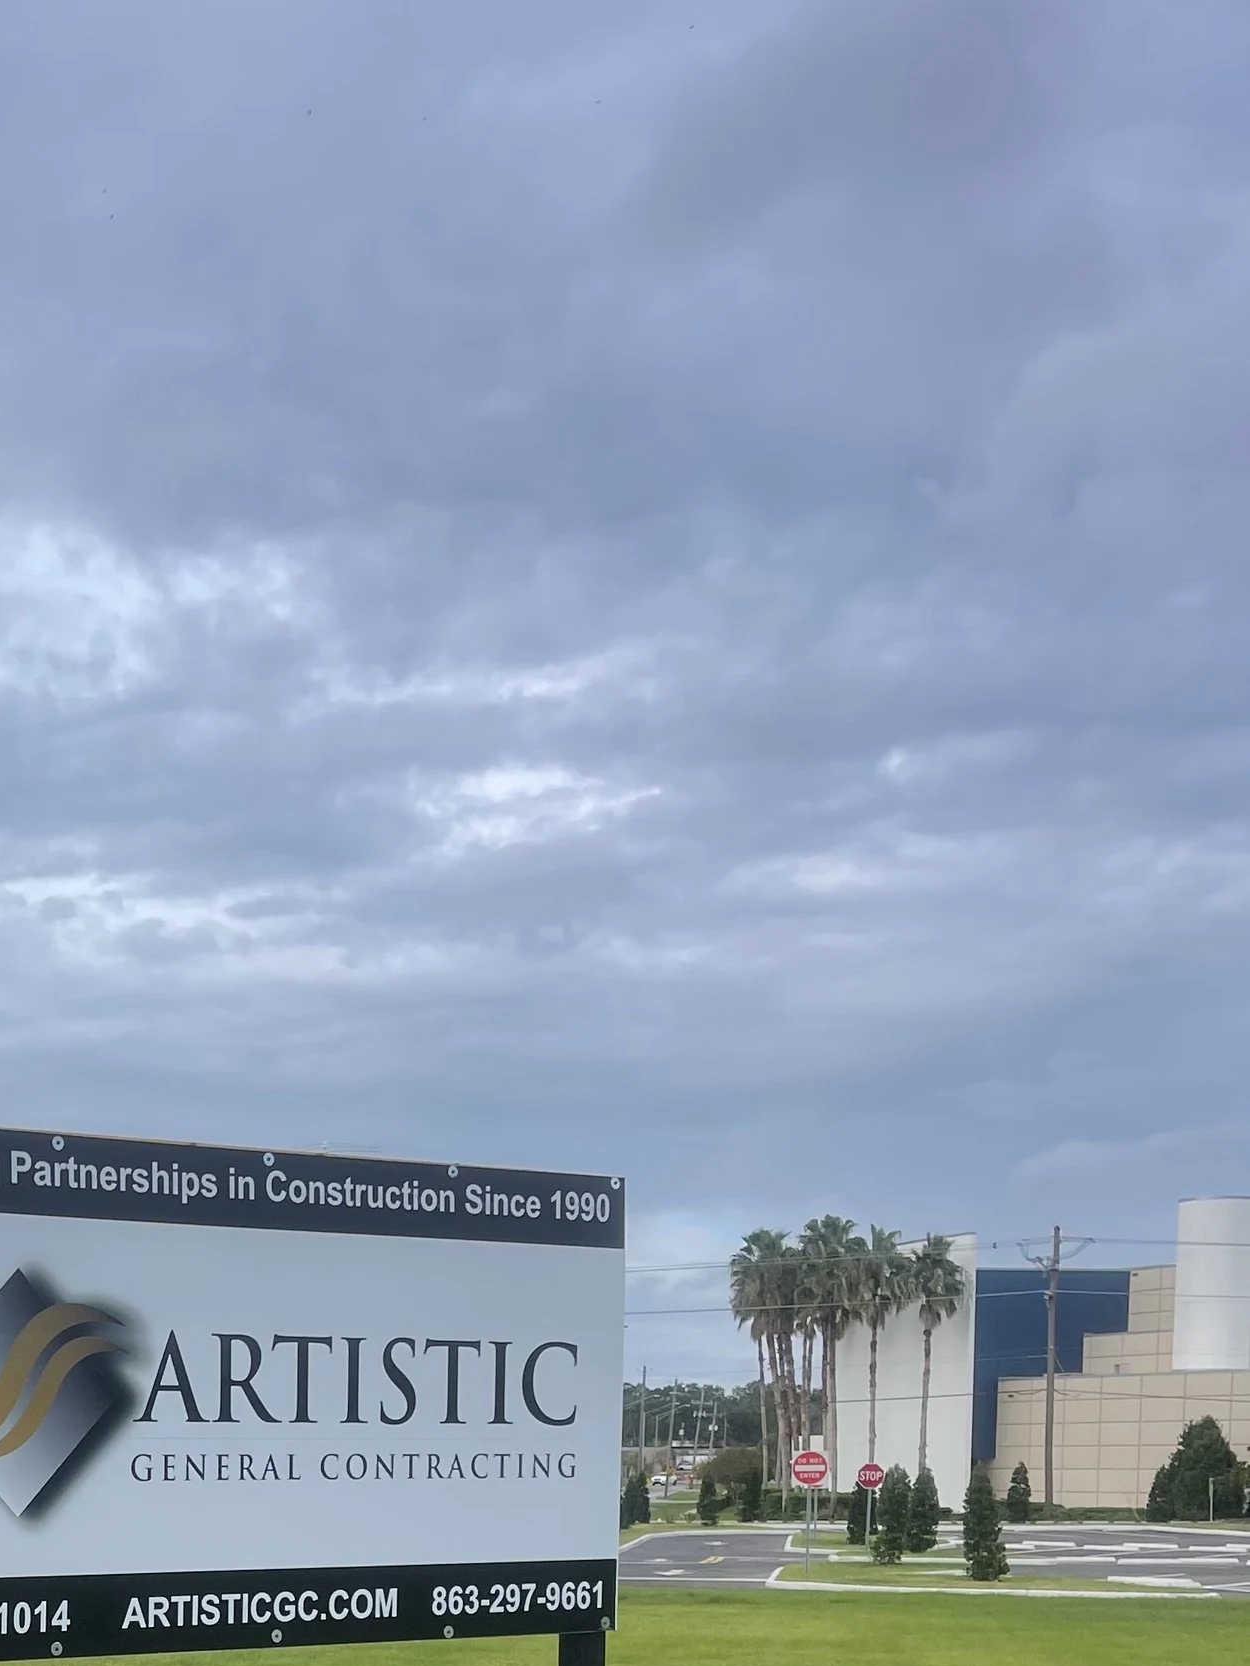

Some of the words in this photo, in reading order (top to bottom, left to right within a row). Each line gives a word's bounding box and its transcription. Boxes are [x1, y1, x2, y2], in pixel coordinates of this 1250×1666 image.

[11, 1150, 217, 1203] Partnerships
[230, 1168, 254, 1200] in
[266, 1170, 455, 1213] Construction
[465, 1184, 540, 1218] Since
[551, 1191, 610, 1222] 1990
[134, 1329, 577, 1426] ARTISTIC
[131, 1454, 300, 1481] GENERAL
[321, 1454, 575, 1480] CONTRACTING
[859, 1471, 883, 1481] STOP
[122, 1588, 397, 1628] ARTISTICGC.COM
[432, 1581, 602, 1615] 863-297-9661
